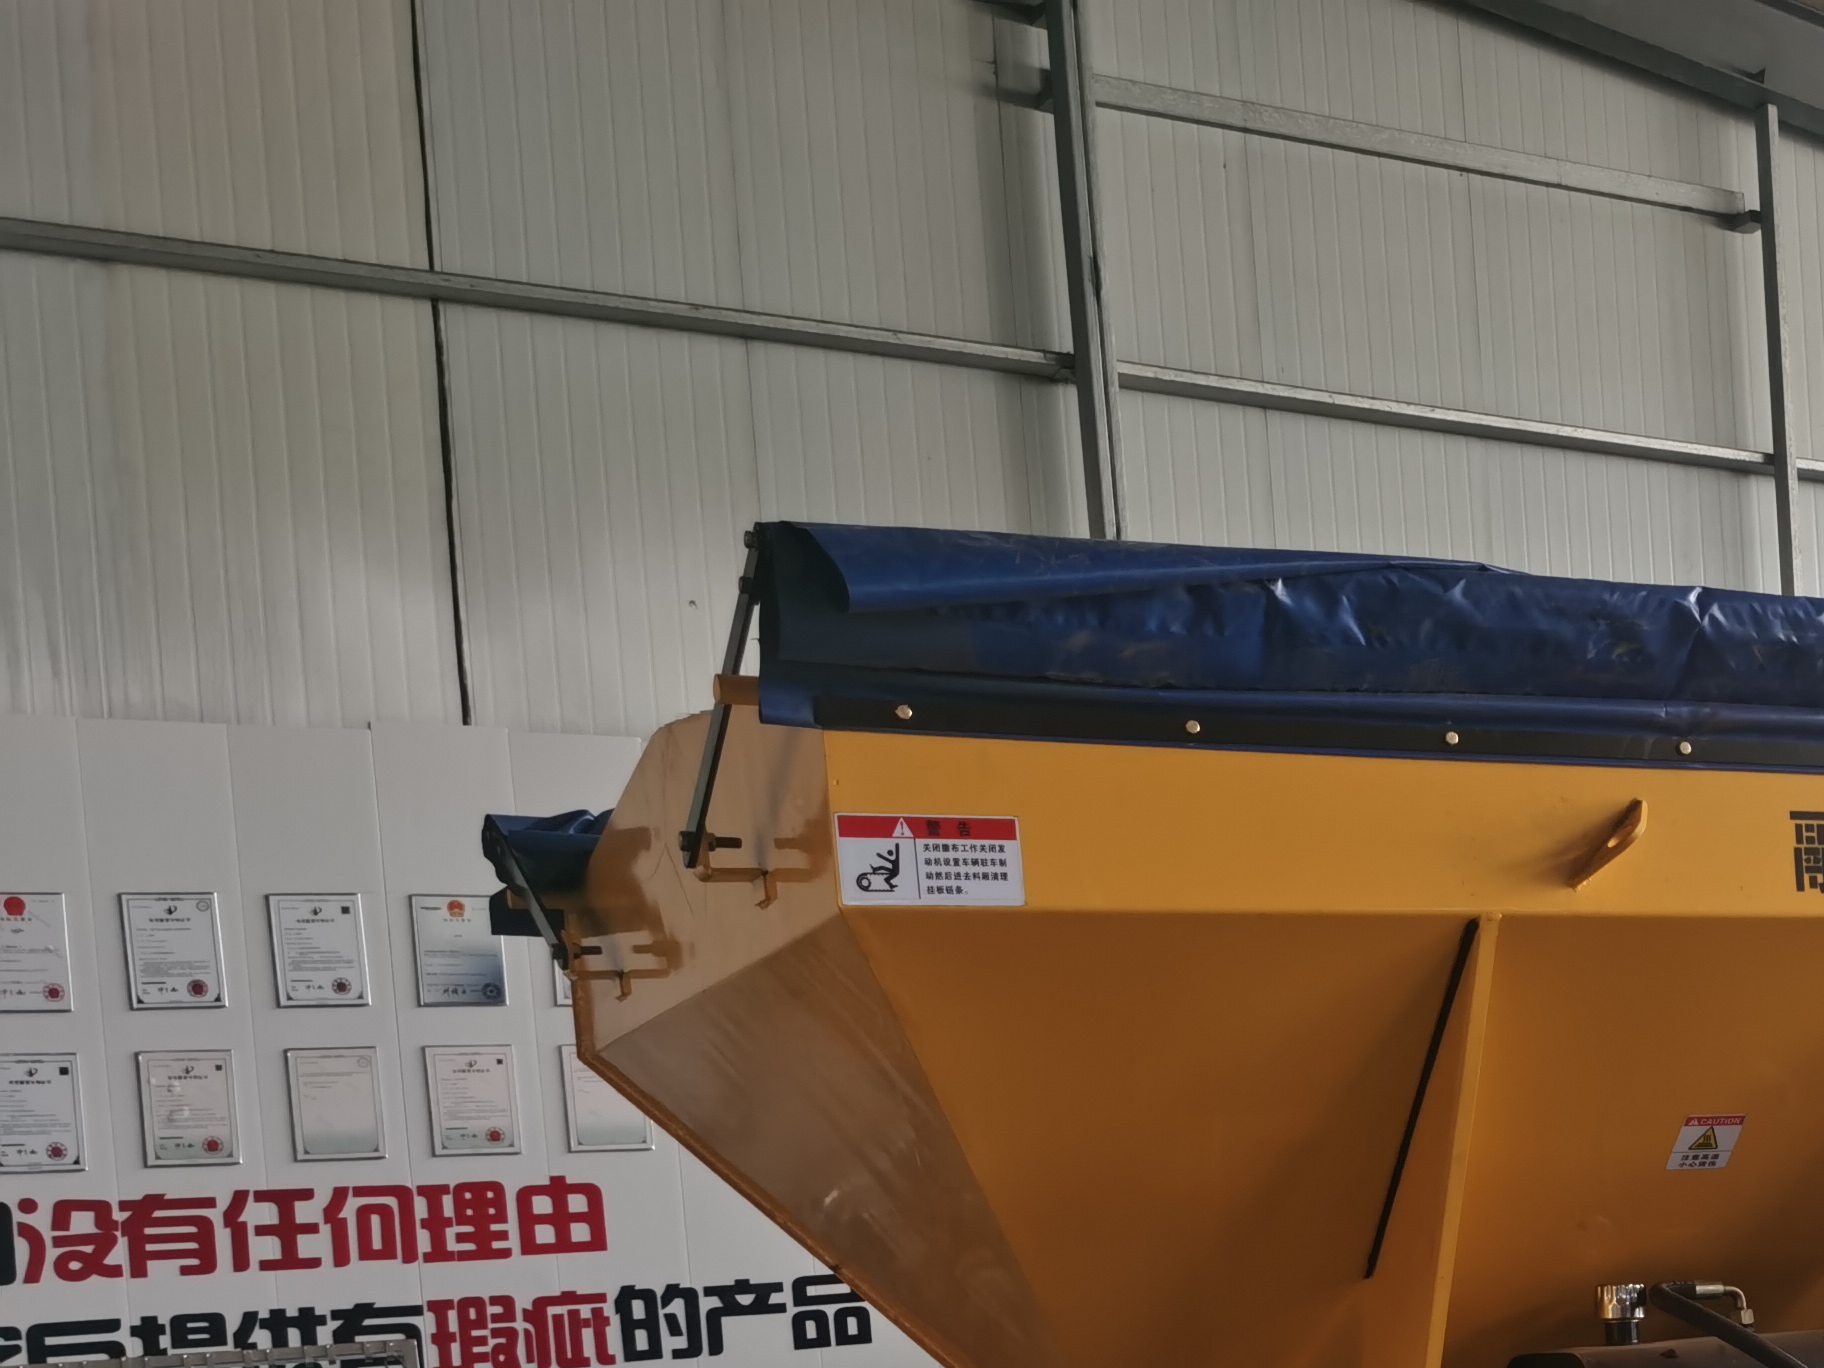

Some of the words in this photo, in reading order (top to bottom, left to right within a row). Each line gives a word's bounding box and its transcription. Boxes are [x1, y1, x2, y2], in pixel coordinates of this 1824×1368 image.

[1701, 1117, 1741, 1125] CAUTION
[0, 1175, 608, 1286] 没有任何理由
